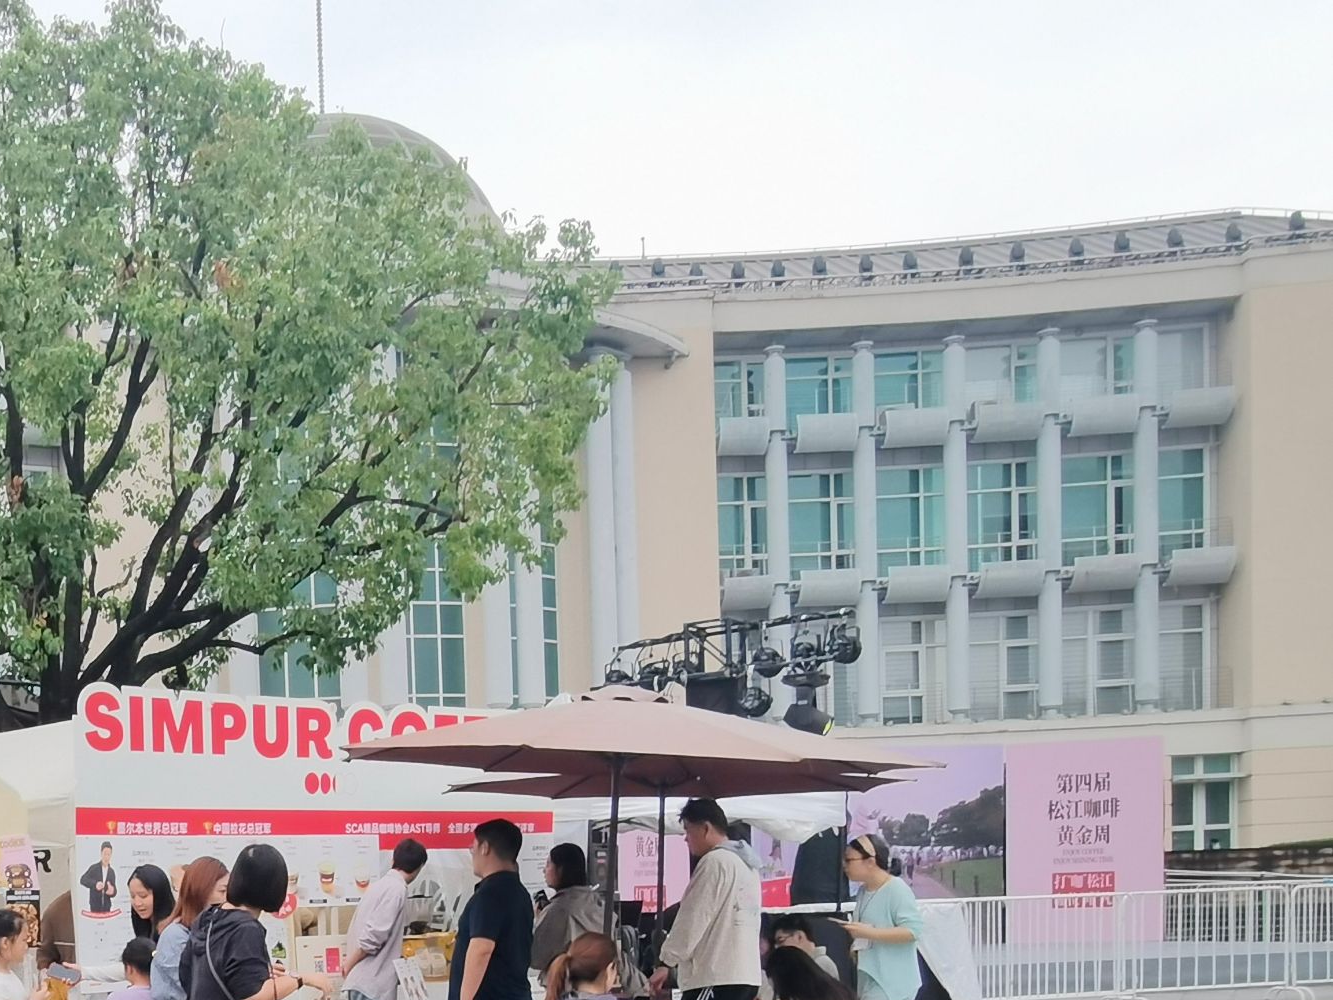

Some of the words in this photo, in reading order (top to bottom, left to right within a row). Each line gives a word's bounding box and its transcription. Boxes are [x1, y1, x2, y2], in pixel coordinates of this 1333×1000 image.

[85, 691, 334, 760] SIMPUR
[1057, 772, 1111, 794] 第四届
[1048, 797, 1120, 821] 松江咖啡
[636, 835, 658, 858] 黄金
[1058, 824, 1111, 846] 黄金周
